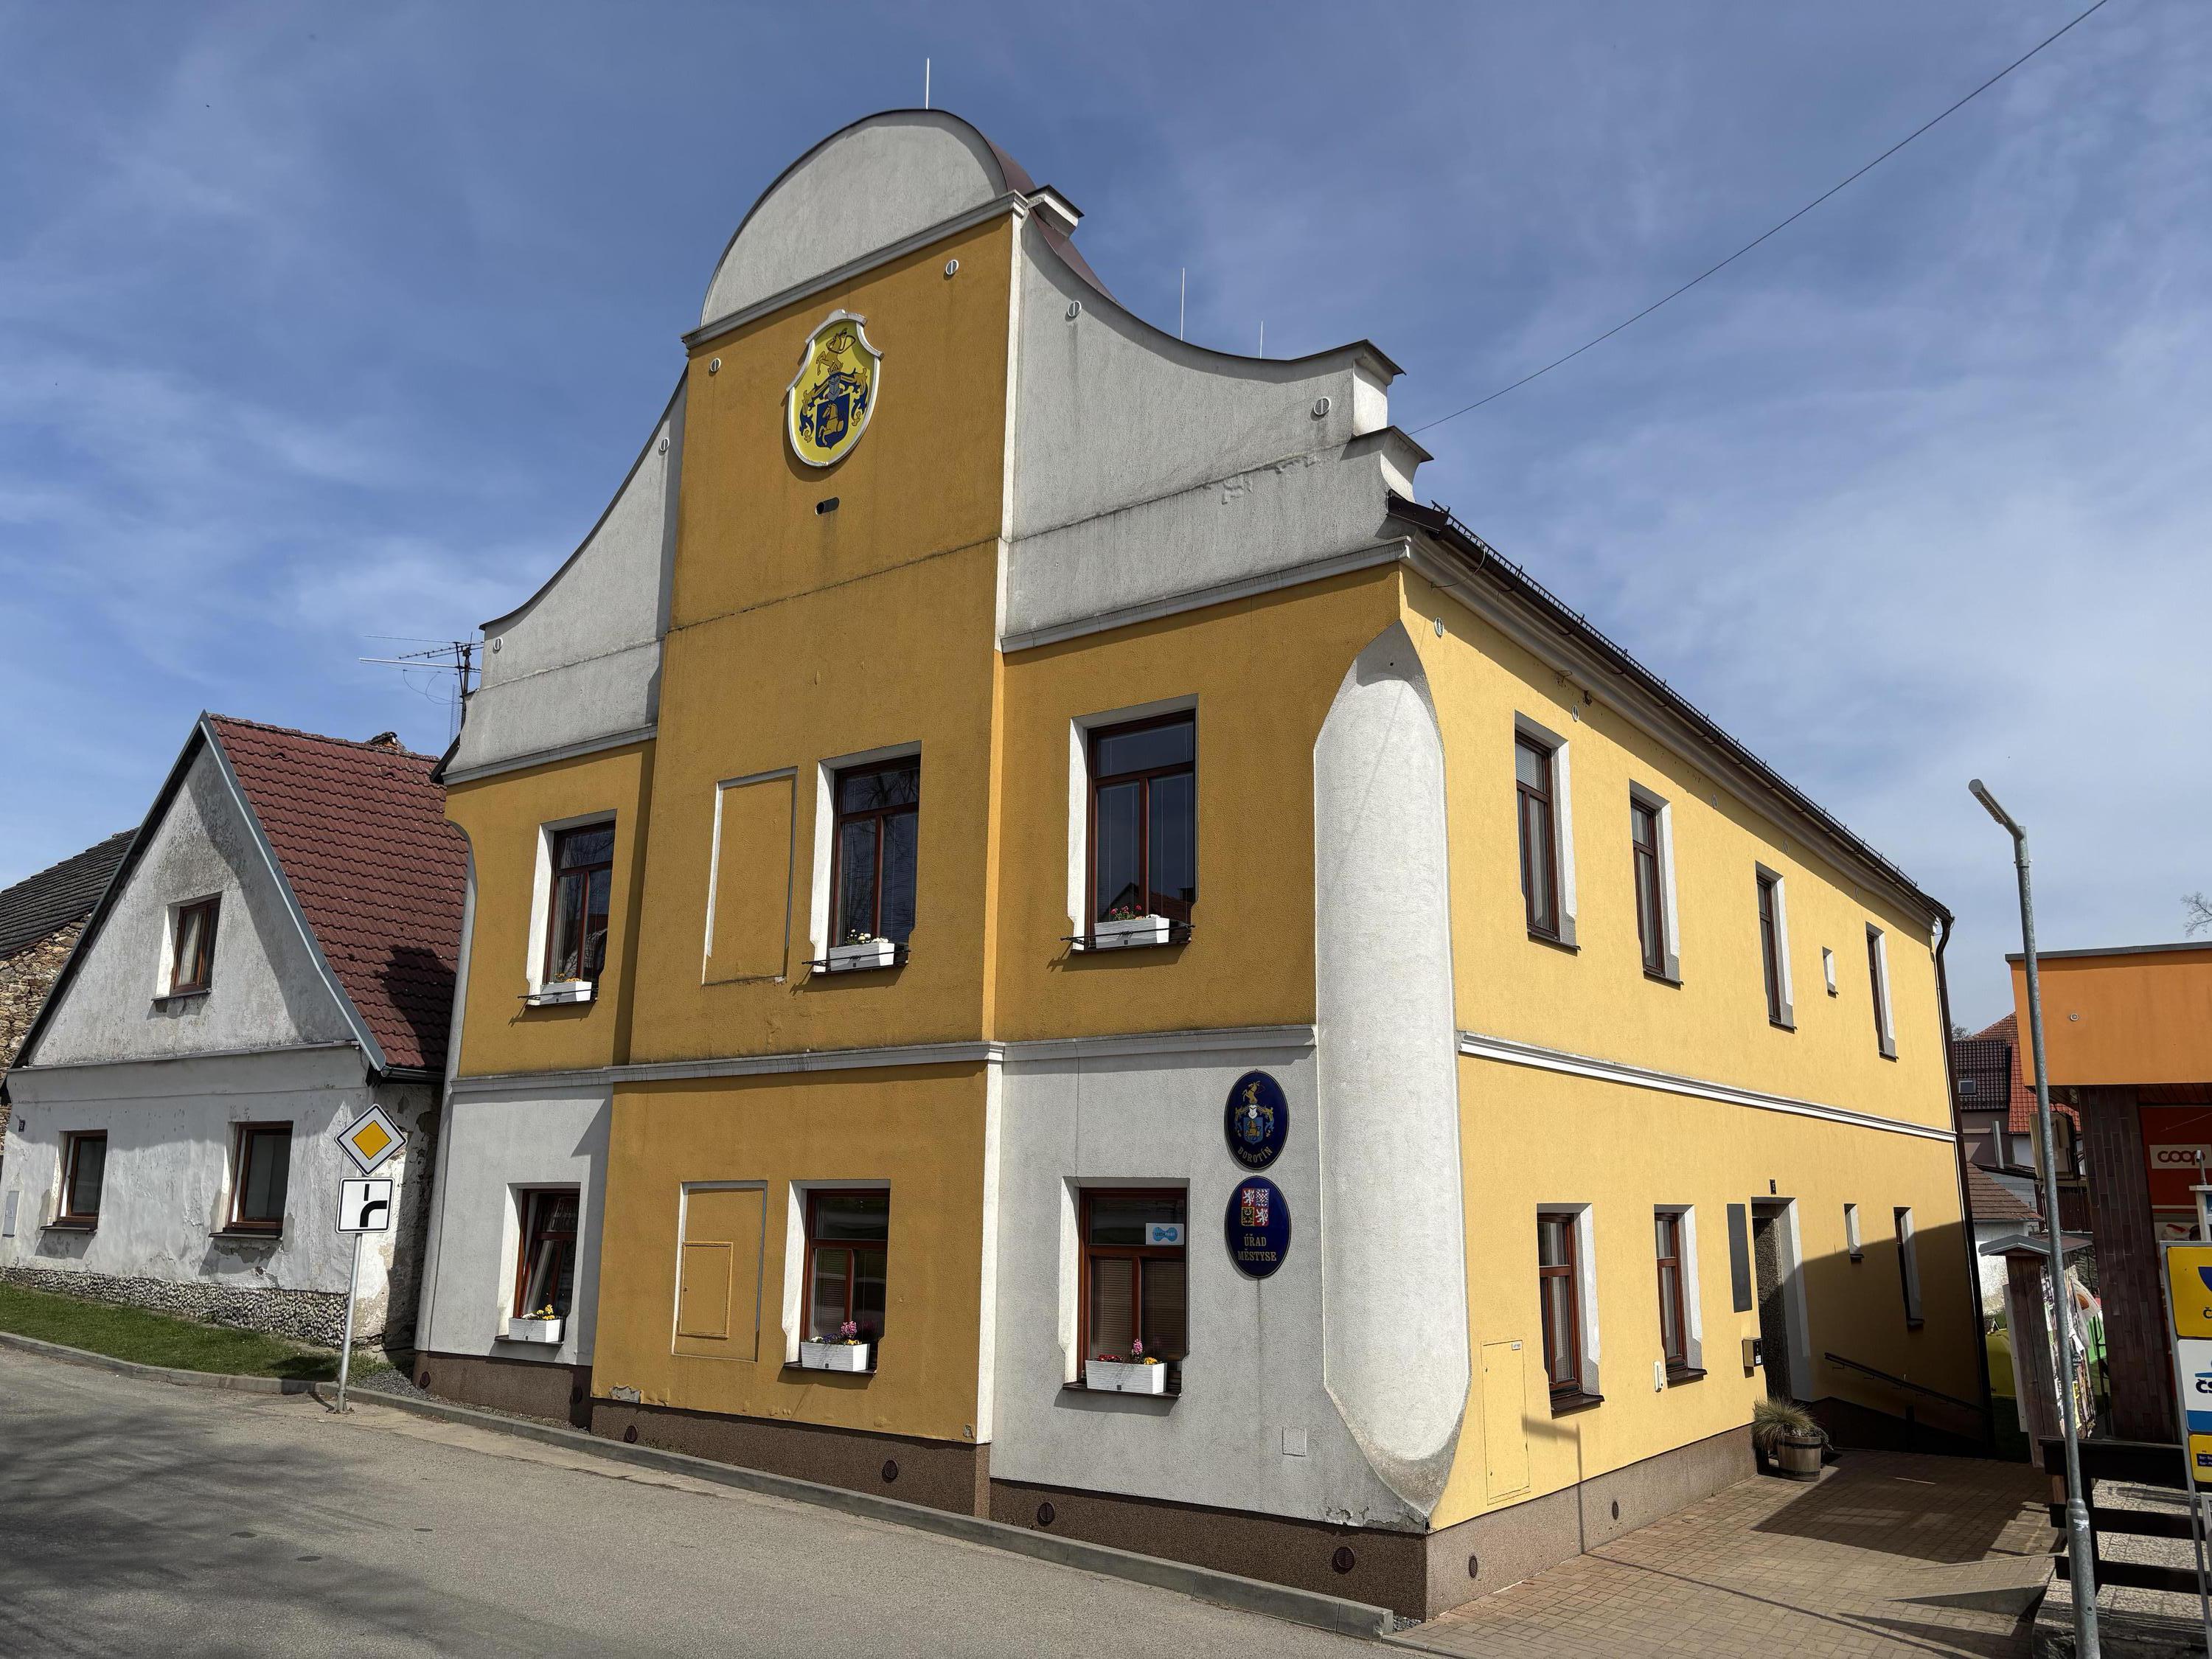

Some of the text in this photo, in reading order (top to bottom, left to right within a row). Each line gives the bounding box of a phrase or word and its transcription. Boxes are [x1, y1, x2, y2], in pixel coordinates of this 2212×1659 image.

[1238, 1147, 1273, 1163] BOROTÍN
[1244, 1233, 1267, 1247] ÚŘAD
[1238, 1248, 1277, 1262] MĚSTYSE
